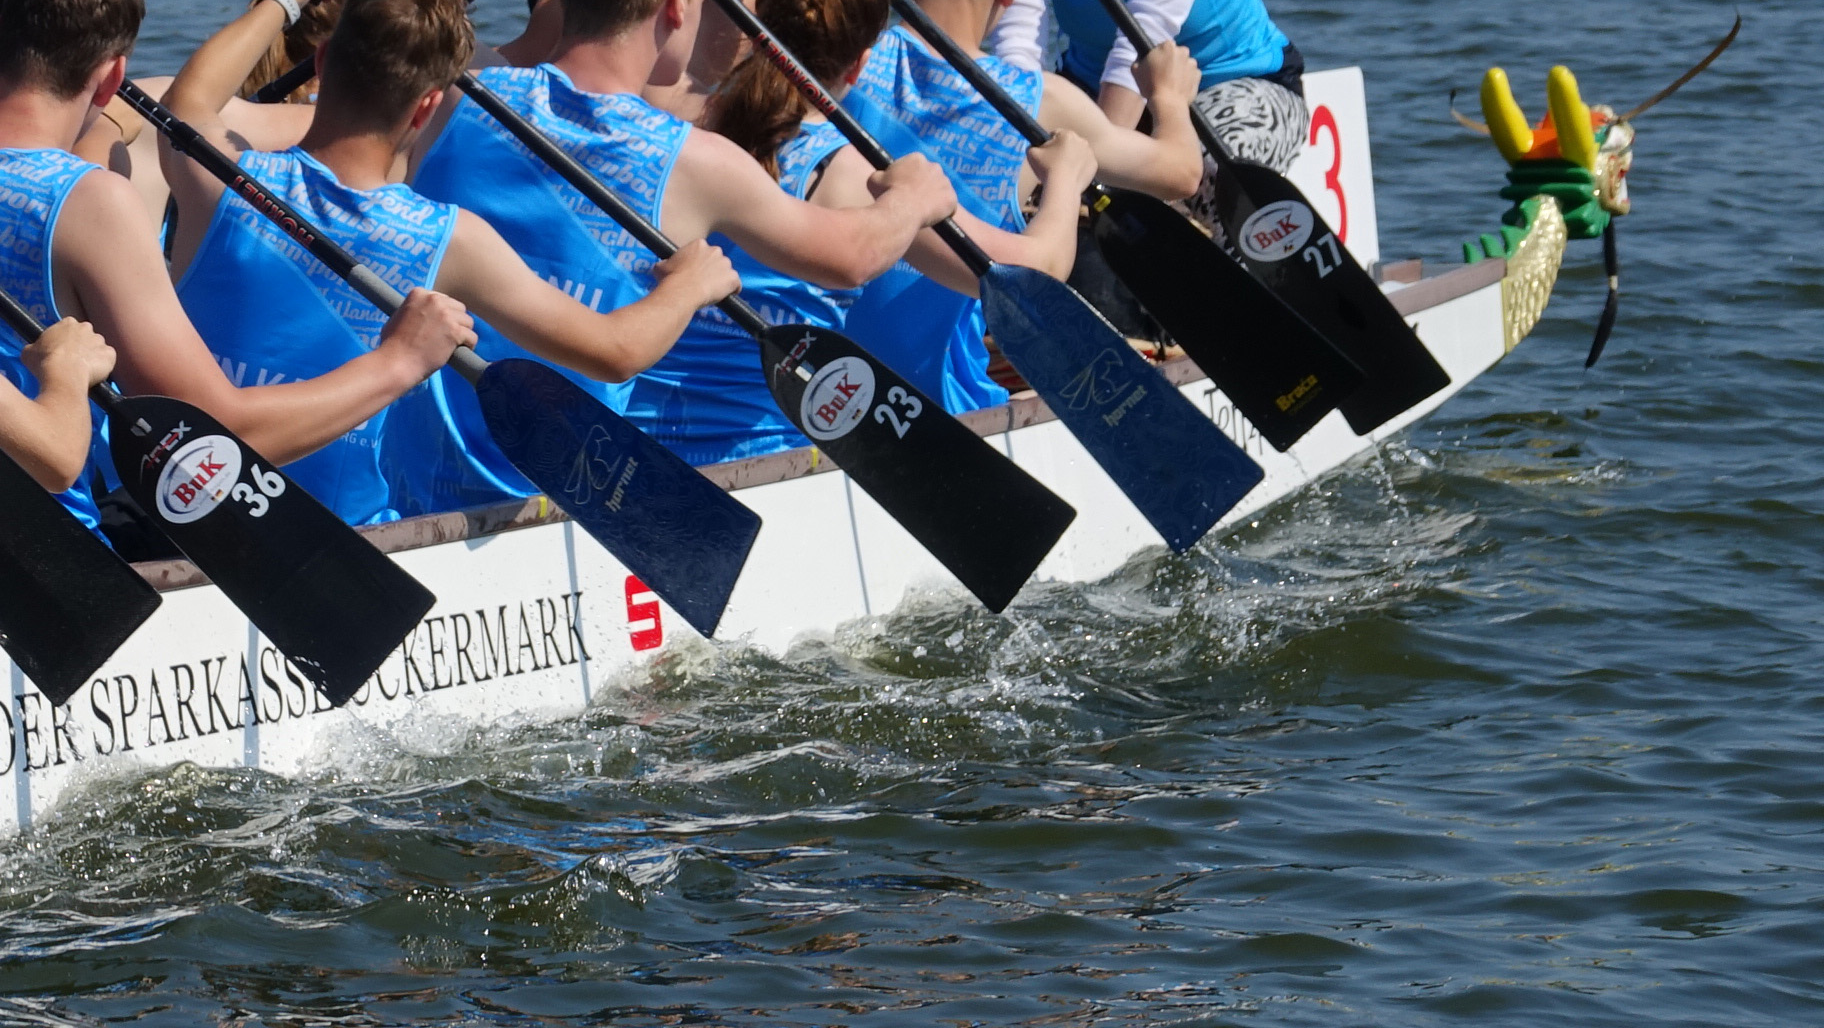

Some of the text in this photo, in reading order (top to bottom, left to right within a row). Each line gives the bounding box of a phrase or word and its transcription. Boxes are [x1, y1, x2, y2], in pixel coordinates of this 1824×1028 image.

[1307, 103, 1349, 245] 3
[231, 174, 316, 248] HORNET
[1254, 213, 1301, 250] BuK
[1303, 232, 1342, 279] 27
[815, 372, 863, 428] BuK
[874, 385, 923, 440] 23
[1103, 384, 1148, 428] hornet
[172, 450, 228, 509] BuK
[231, 463, 286, 518] 36
[90, 646, 336, 757] SPARKASS
[348, 590, 593, 707] KERMARK
